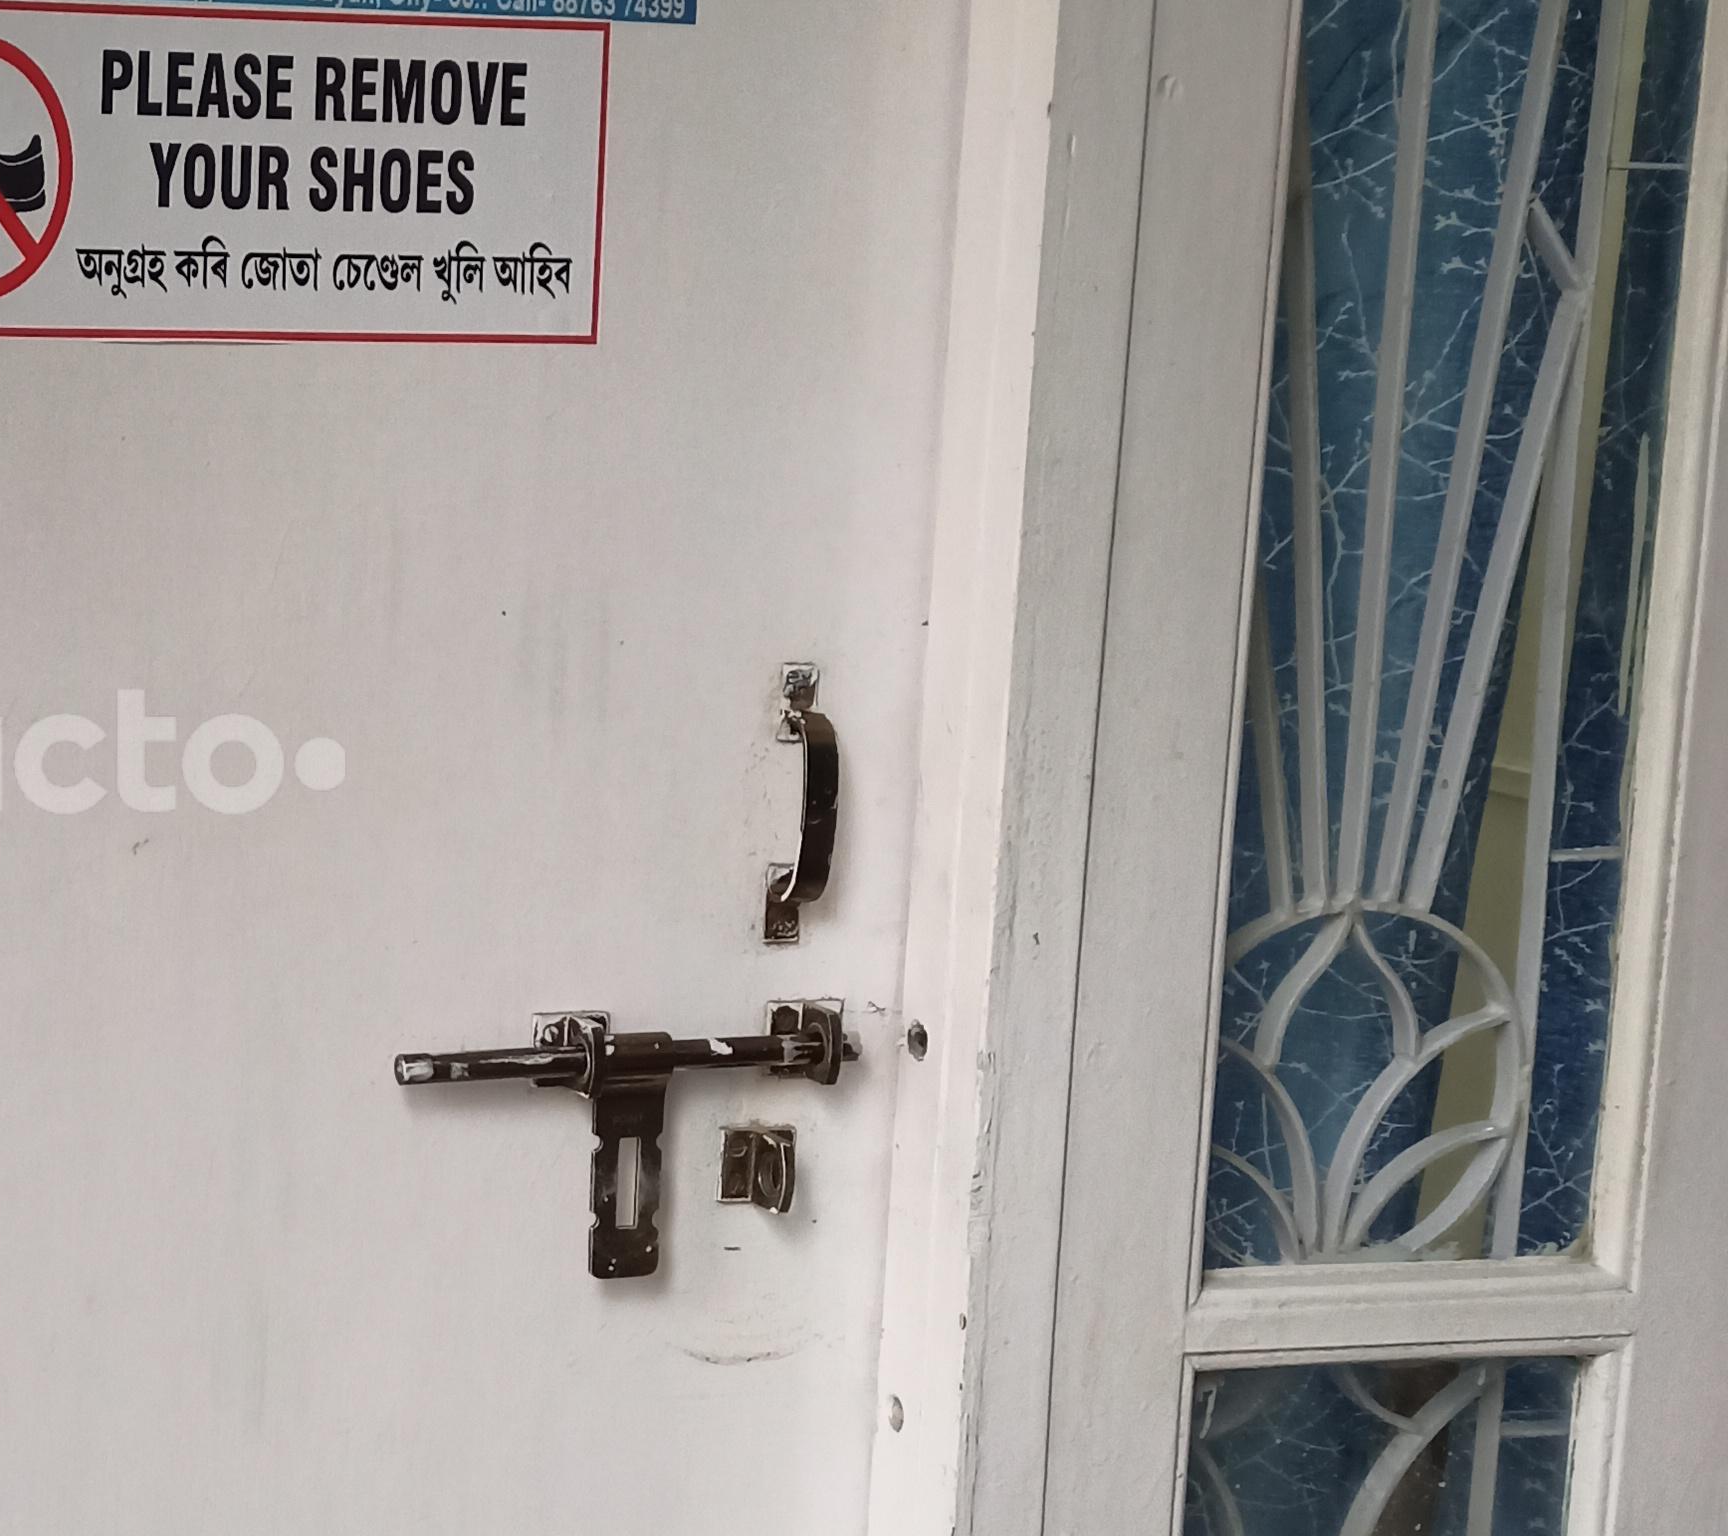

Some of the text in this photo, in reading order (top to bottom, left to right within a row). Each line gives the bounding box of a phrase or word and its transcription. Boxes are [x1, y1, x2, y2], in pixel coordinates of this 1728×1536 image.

[101, 49, 528, 126] PLEASE REMOVE
[150, 142, 475, 215] YOUR SHOES
[242, 248, 323, 292] জোতা
[433, 240, 486, 304] খুলি
